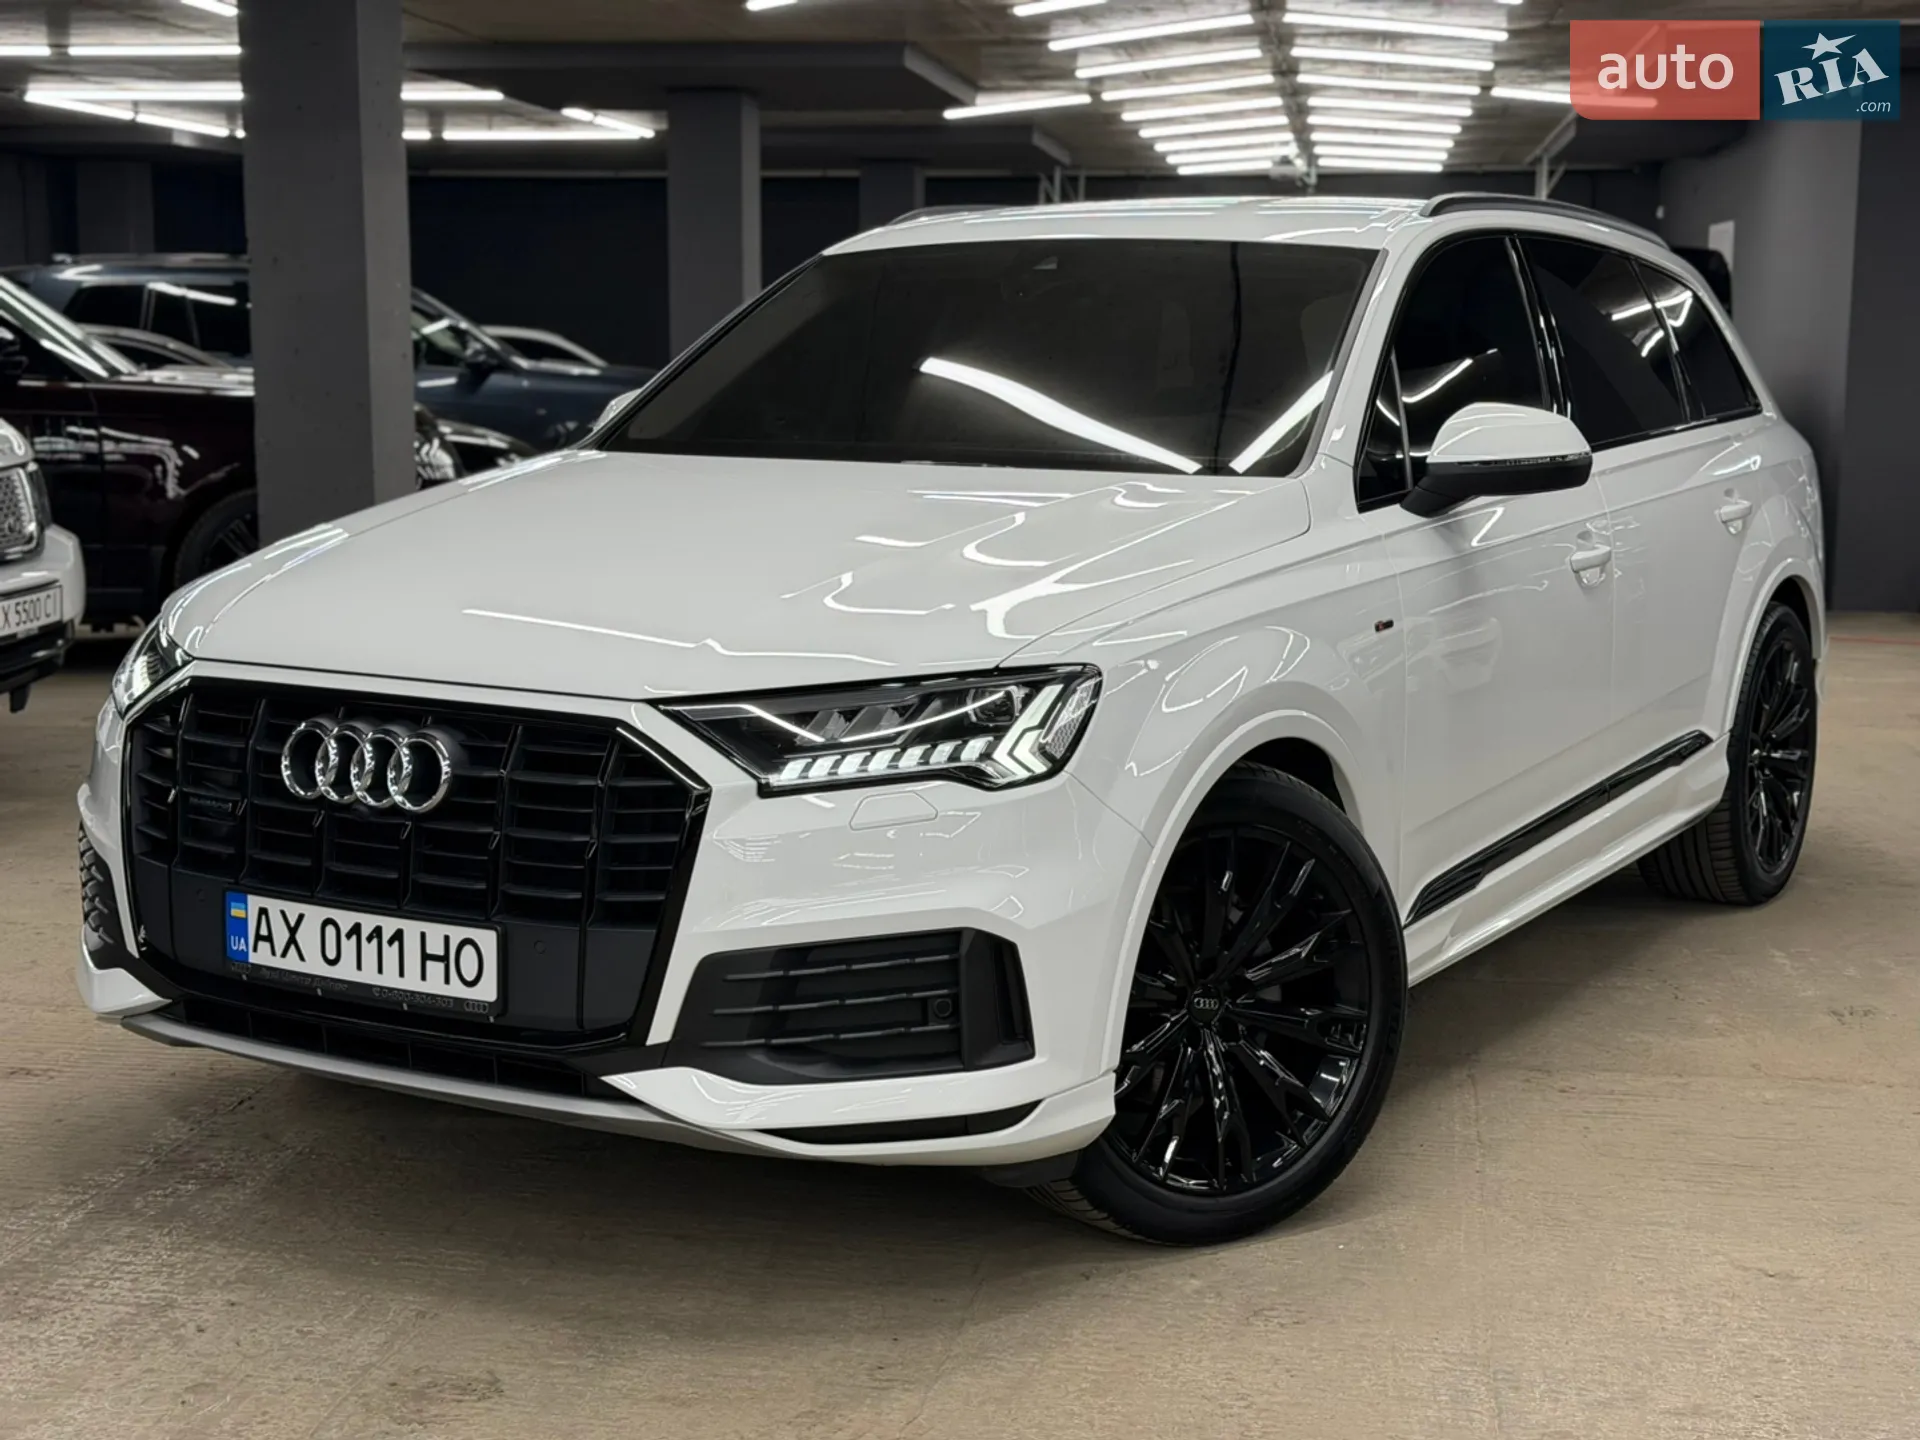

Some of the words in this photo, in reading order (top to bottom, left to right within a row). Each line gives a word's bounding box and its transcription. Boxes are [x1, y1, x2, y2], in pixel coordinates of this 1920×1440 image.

[15, 597, 41, 626] 5500
[230, 935, 247, 952] UA
[252, 906, 306, 962] AX
[320, 917, 405, 978] 0111
[420, 931, 484, 988] HO
